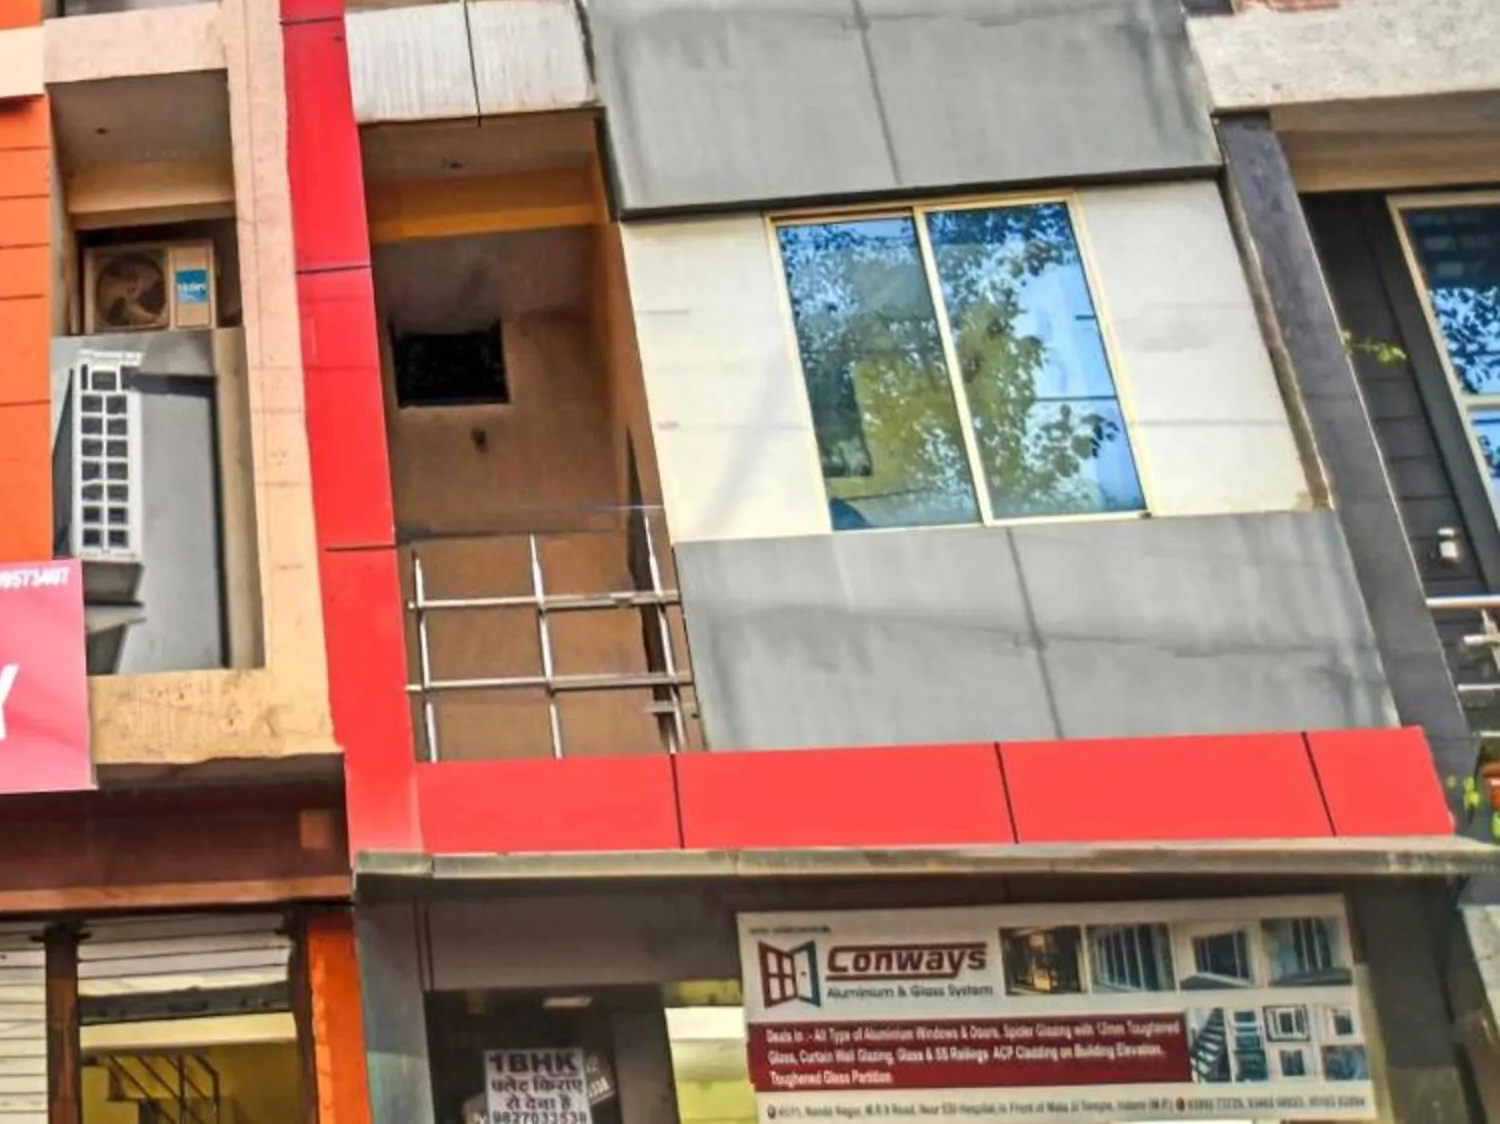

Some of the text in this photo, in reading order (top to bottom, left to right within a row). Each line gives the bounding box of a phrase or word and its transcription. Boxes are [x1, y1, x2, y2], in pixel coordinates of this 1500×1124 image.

[826, 942, 988, 978] Conways
[910, 985, 945, 997] Glass
[948, 983, 994, 997] System
